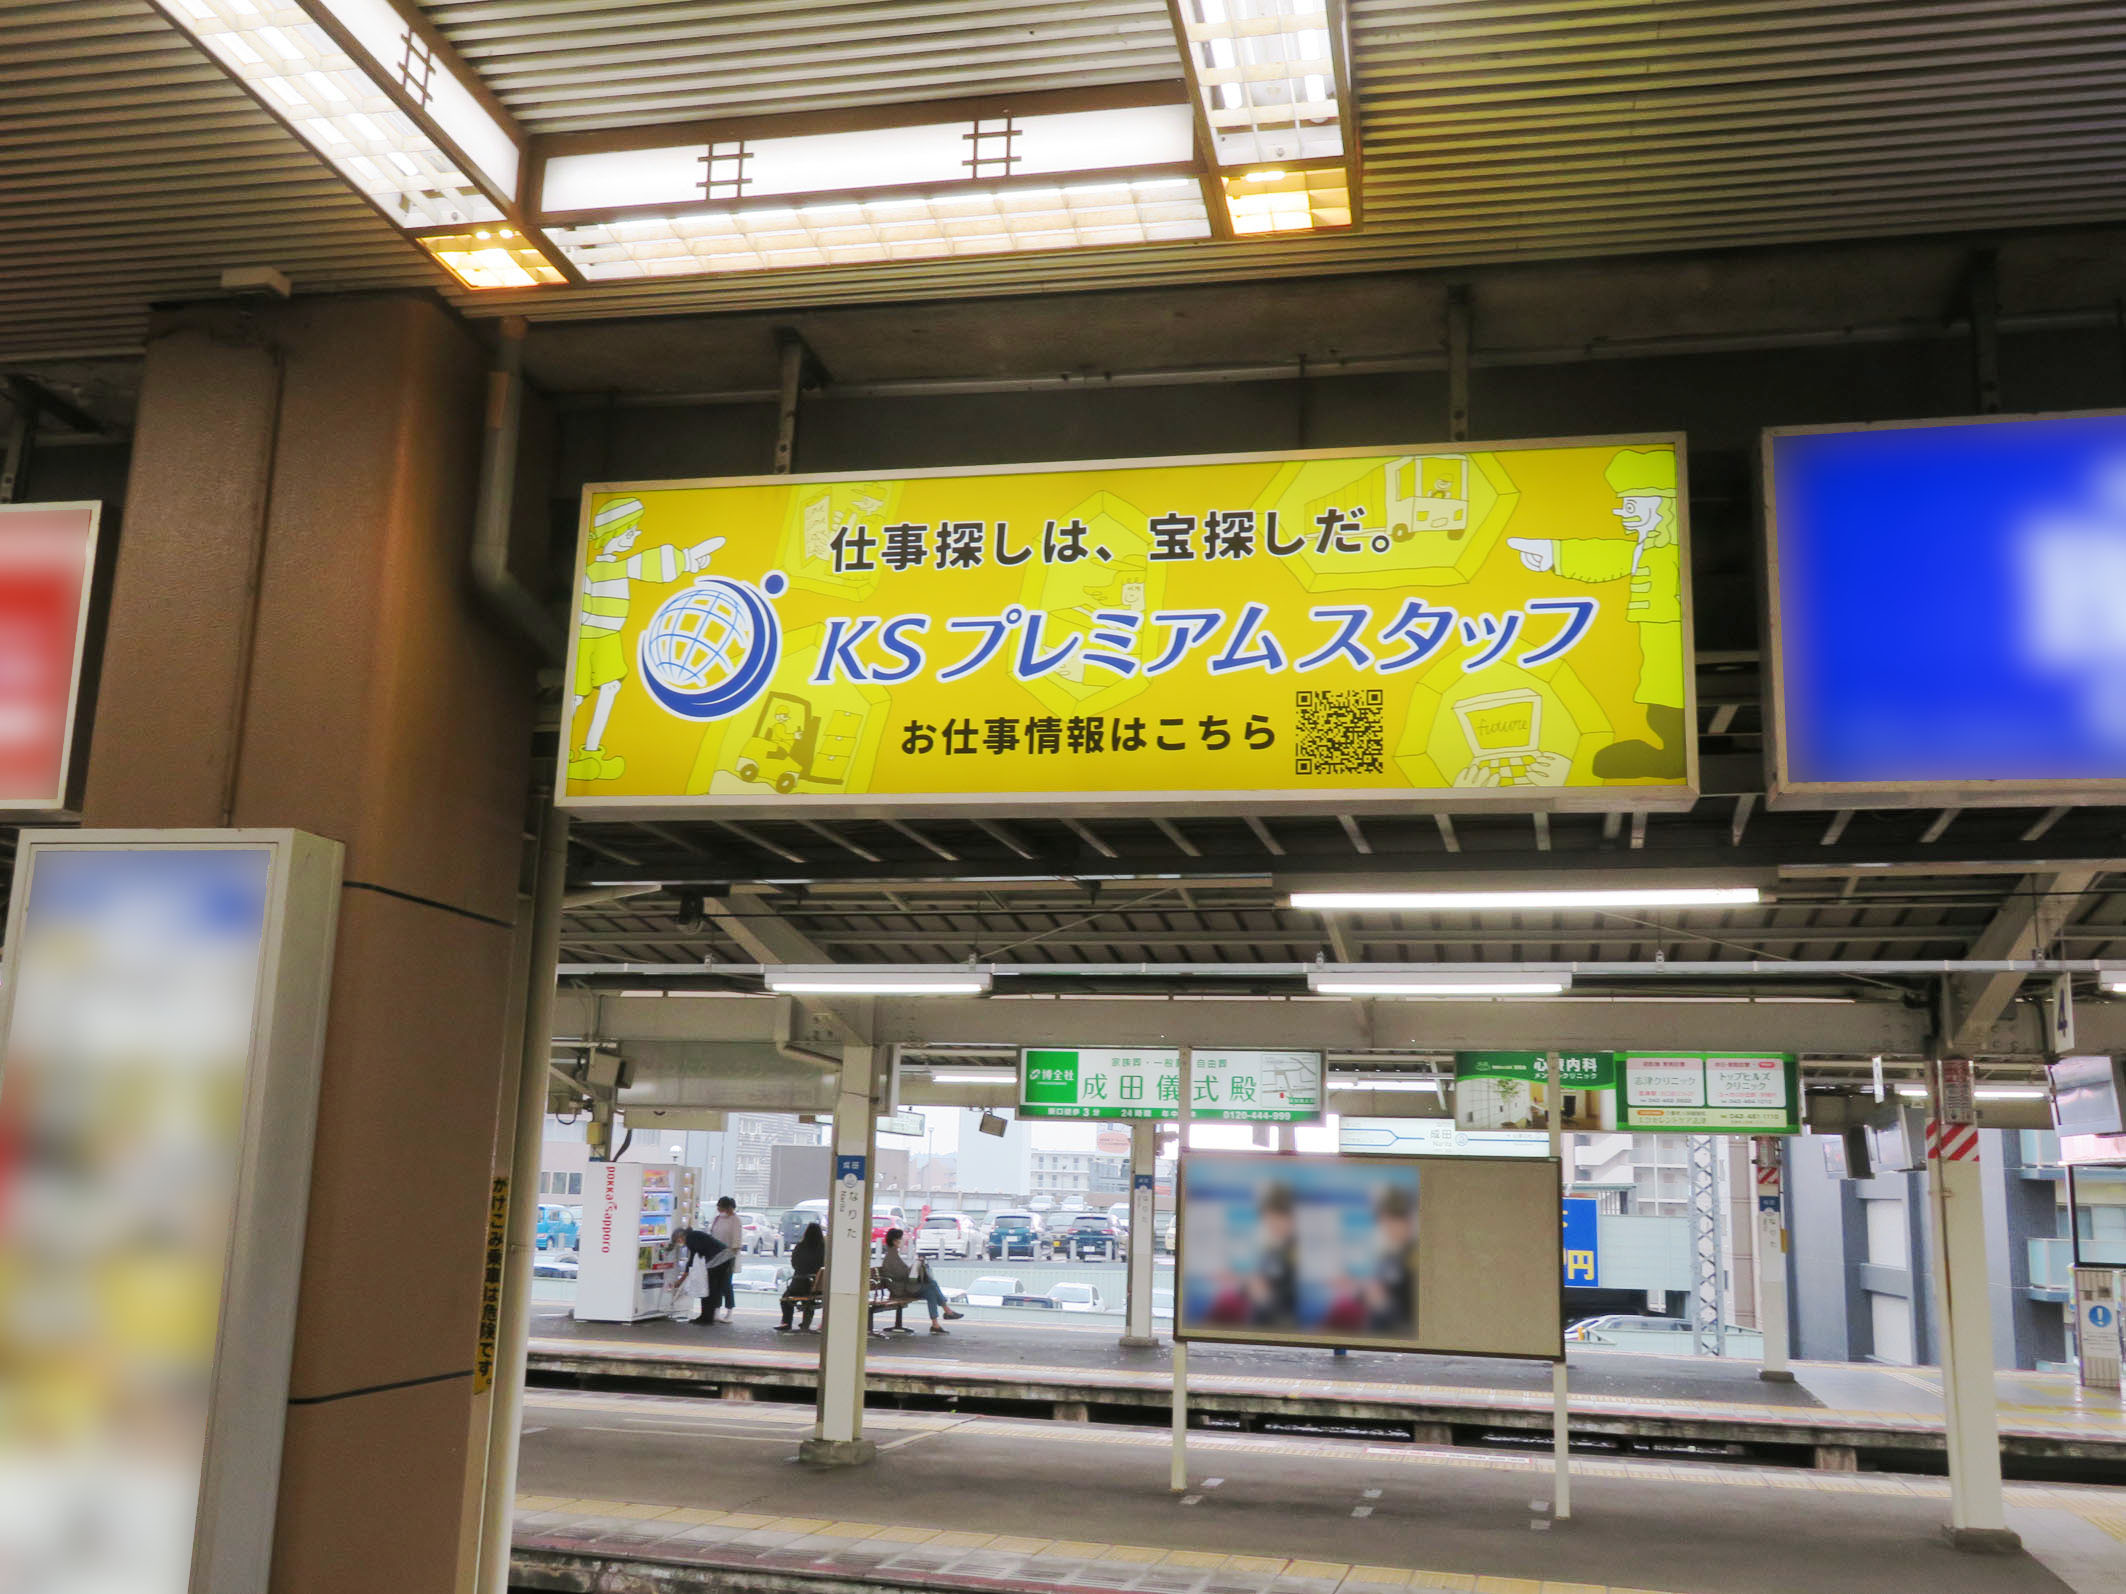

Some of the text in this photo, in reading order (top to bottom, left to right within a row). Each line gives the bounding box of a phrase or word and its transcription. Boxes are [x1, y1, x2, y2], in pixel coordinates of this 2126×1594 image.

[829, 507, 1393, 572] 仕事探しは、宝探しだ。
[902, 713, 1276, 756] お仕事情報はこちら
[2057, 988, 2068, 1038] 4
[1083, 1073, 1256, 1103] 成田儀式殿
[477, 1177, 508, 1385] かけこみ乗車は危険です。
